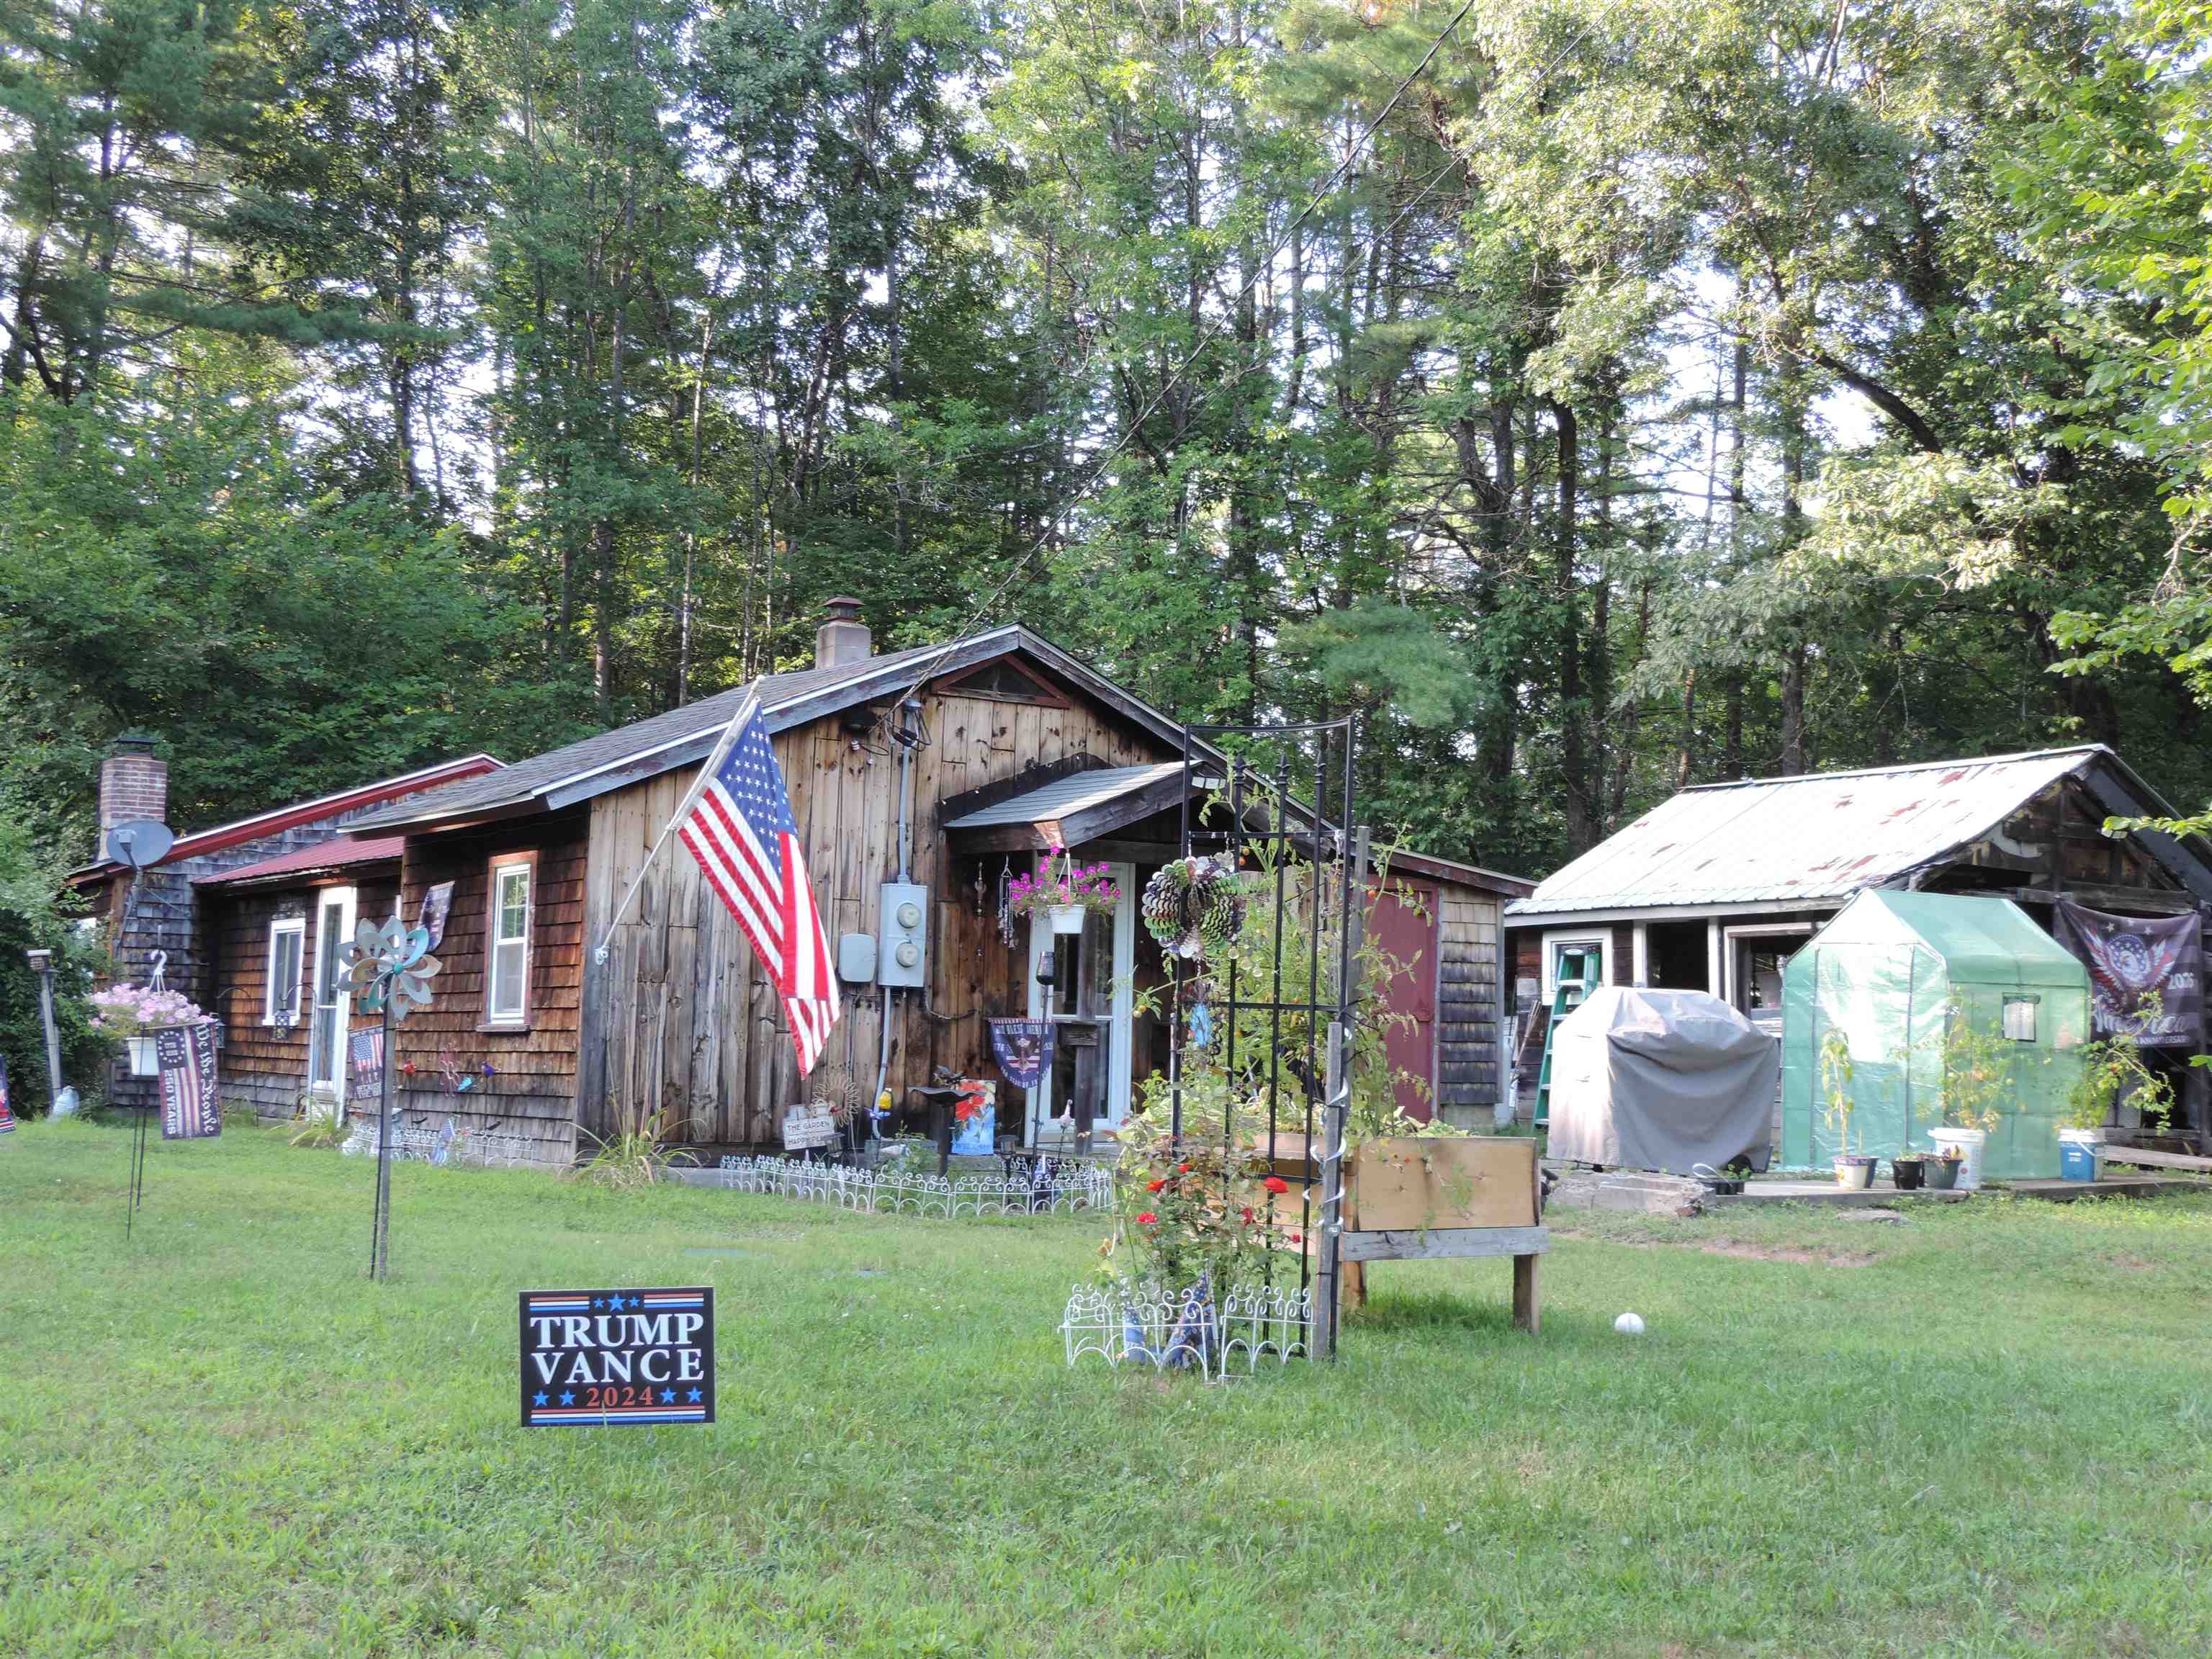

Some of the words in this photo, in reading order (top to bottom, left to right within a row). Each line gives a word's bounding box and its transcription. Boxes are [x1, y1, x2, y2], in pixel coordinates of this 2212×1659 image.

[195, 1022, 210, 1049] We
[199, 1053, 213, 1076] the
[166, 1095, 177, 1135] YEARS
[201, 1079, 219, 1134] People
[803, 1120, 830, 1129] GARDEN
[529, 1313, 703, 1348] TRUMP
[530, 1348, 704, 1384] VANCE
[586, 1386, 654, 1407] 2024
